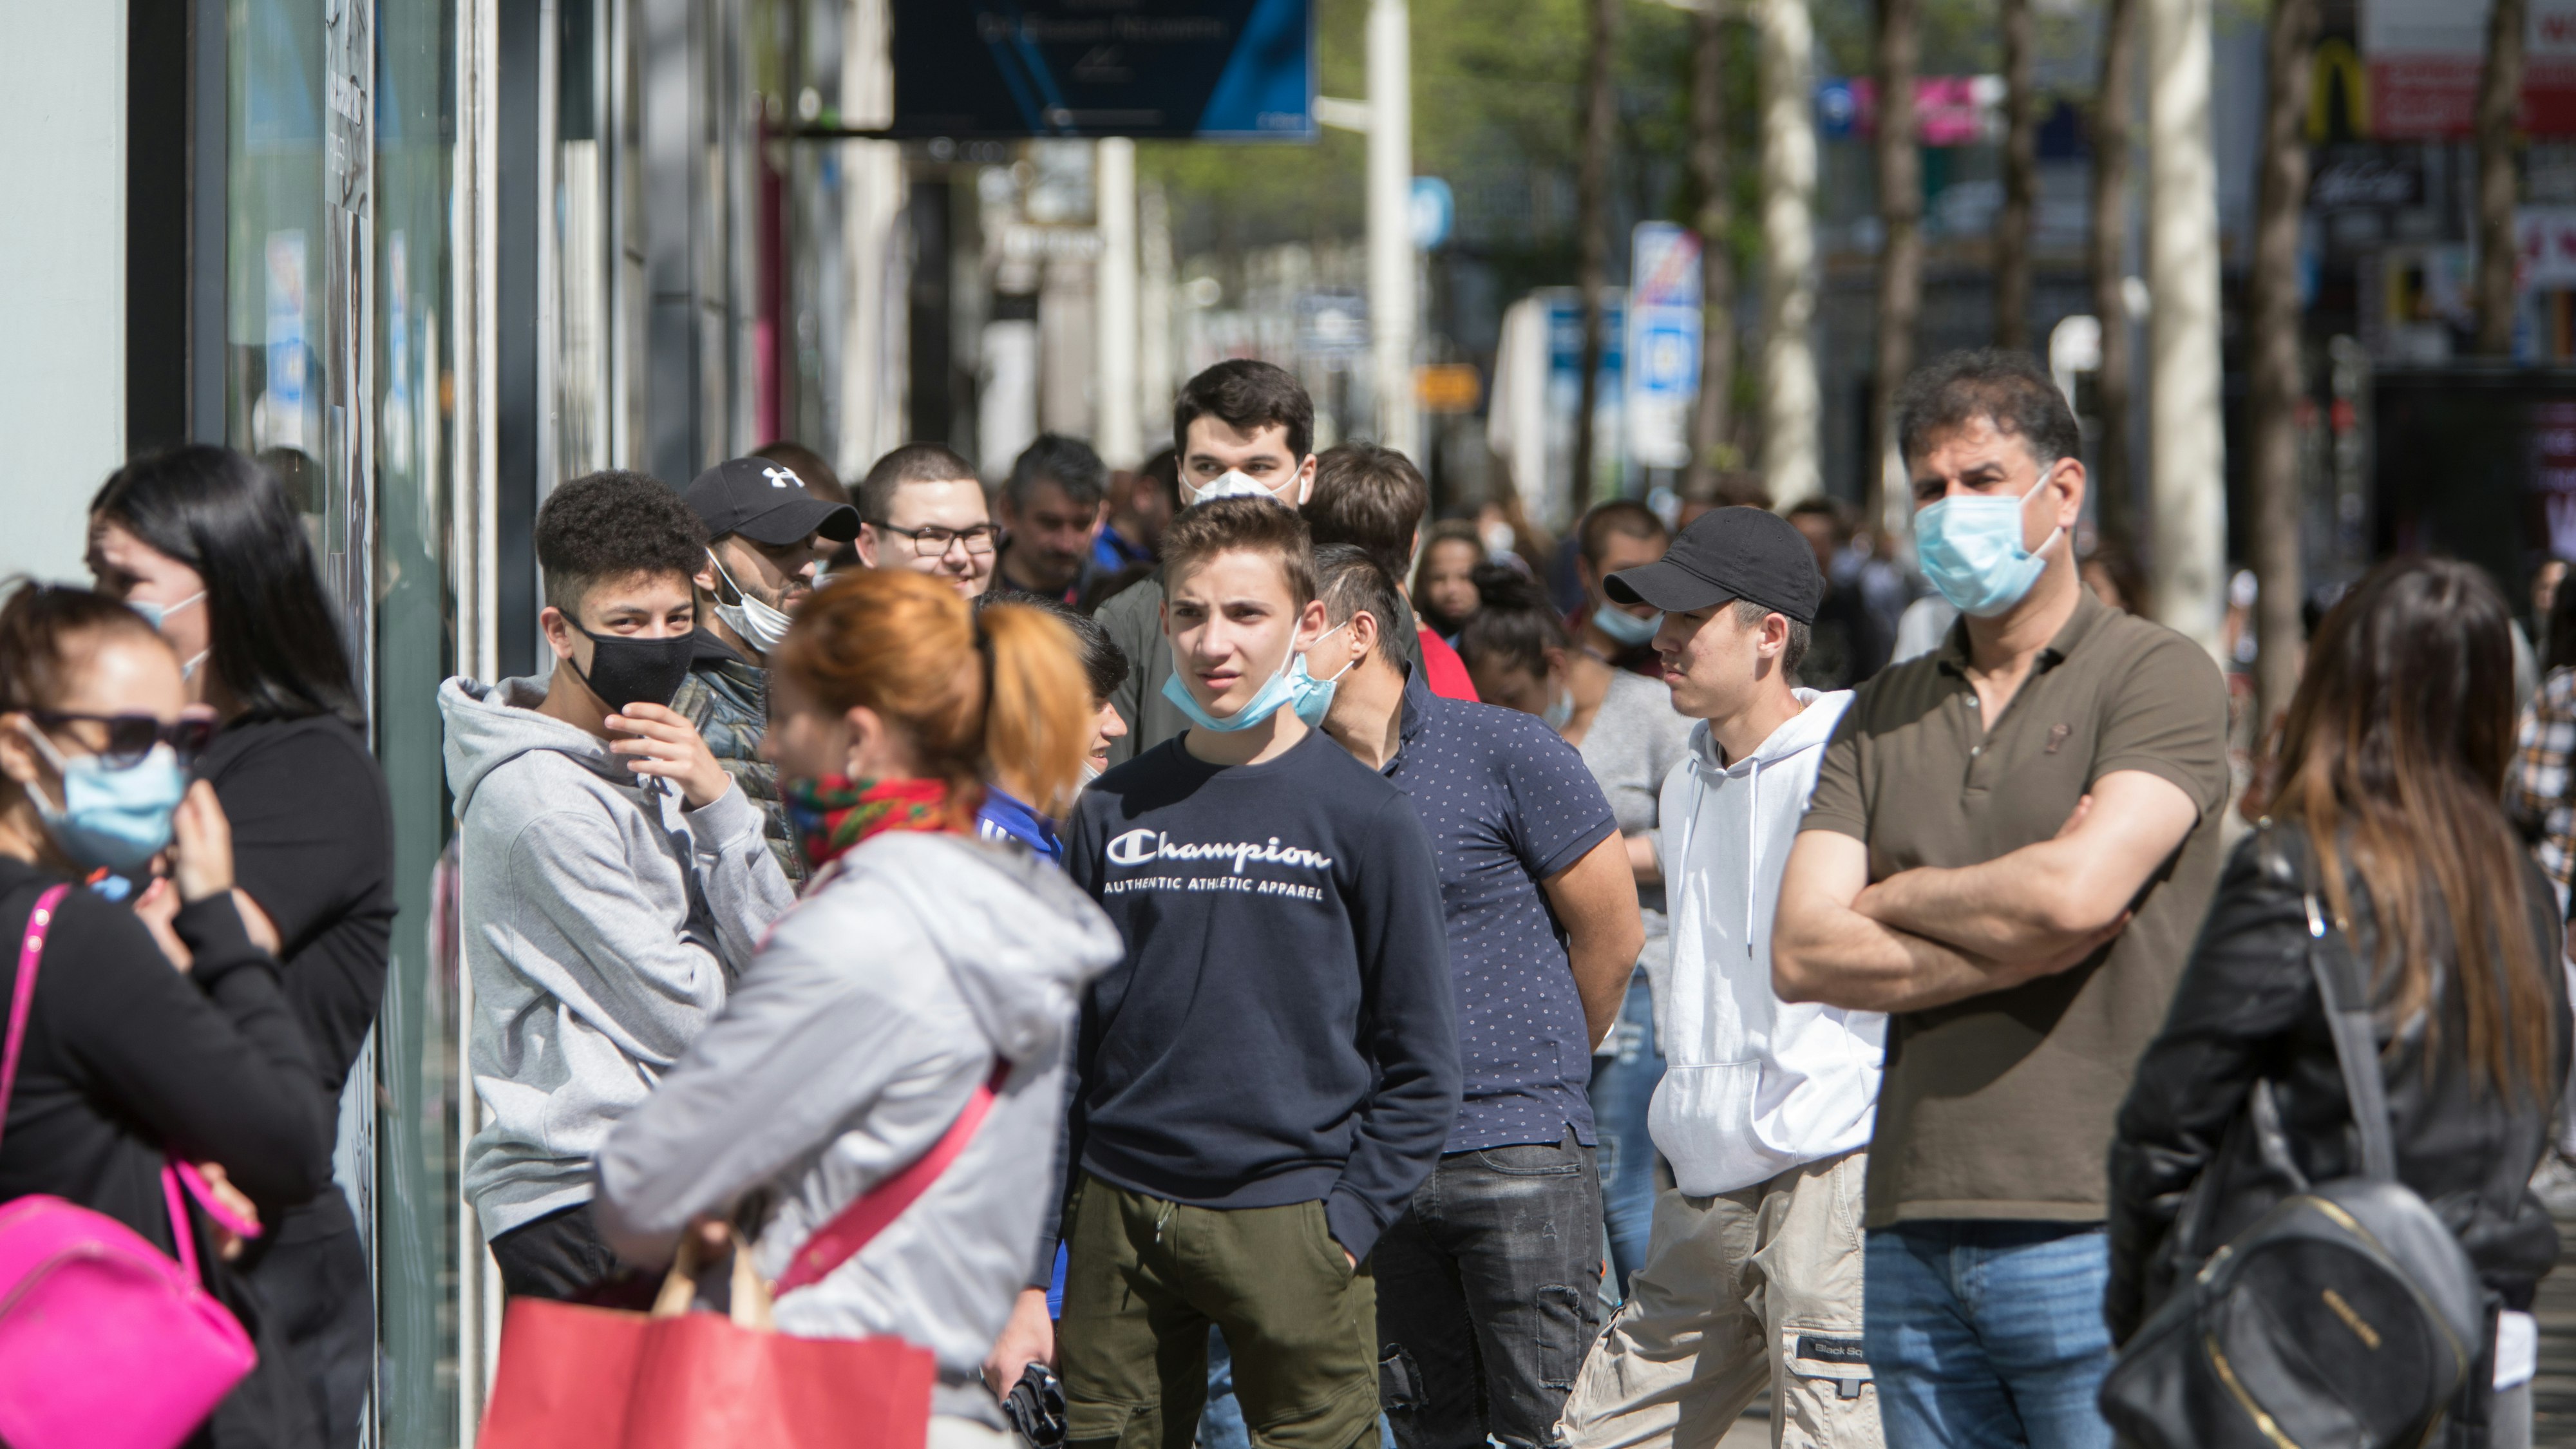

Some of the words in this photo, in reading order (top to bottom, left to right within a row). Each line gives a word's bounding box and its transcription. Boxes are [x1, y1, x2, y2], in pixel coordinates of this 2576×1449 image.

[1106, 828, 1332, 875] Champion
[1104, 876, 1182, 894] AUTHENTIC
[1187, 876, 1253, 892] ATHLETIC
[1257, 880, 1323, 900] APPAREL
[1815, 1343, 1845, 1355] Black
[1846, 1347, 1863, 1358] Sq
